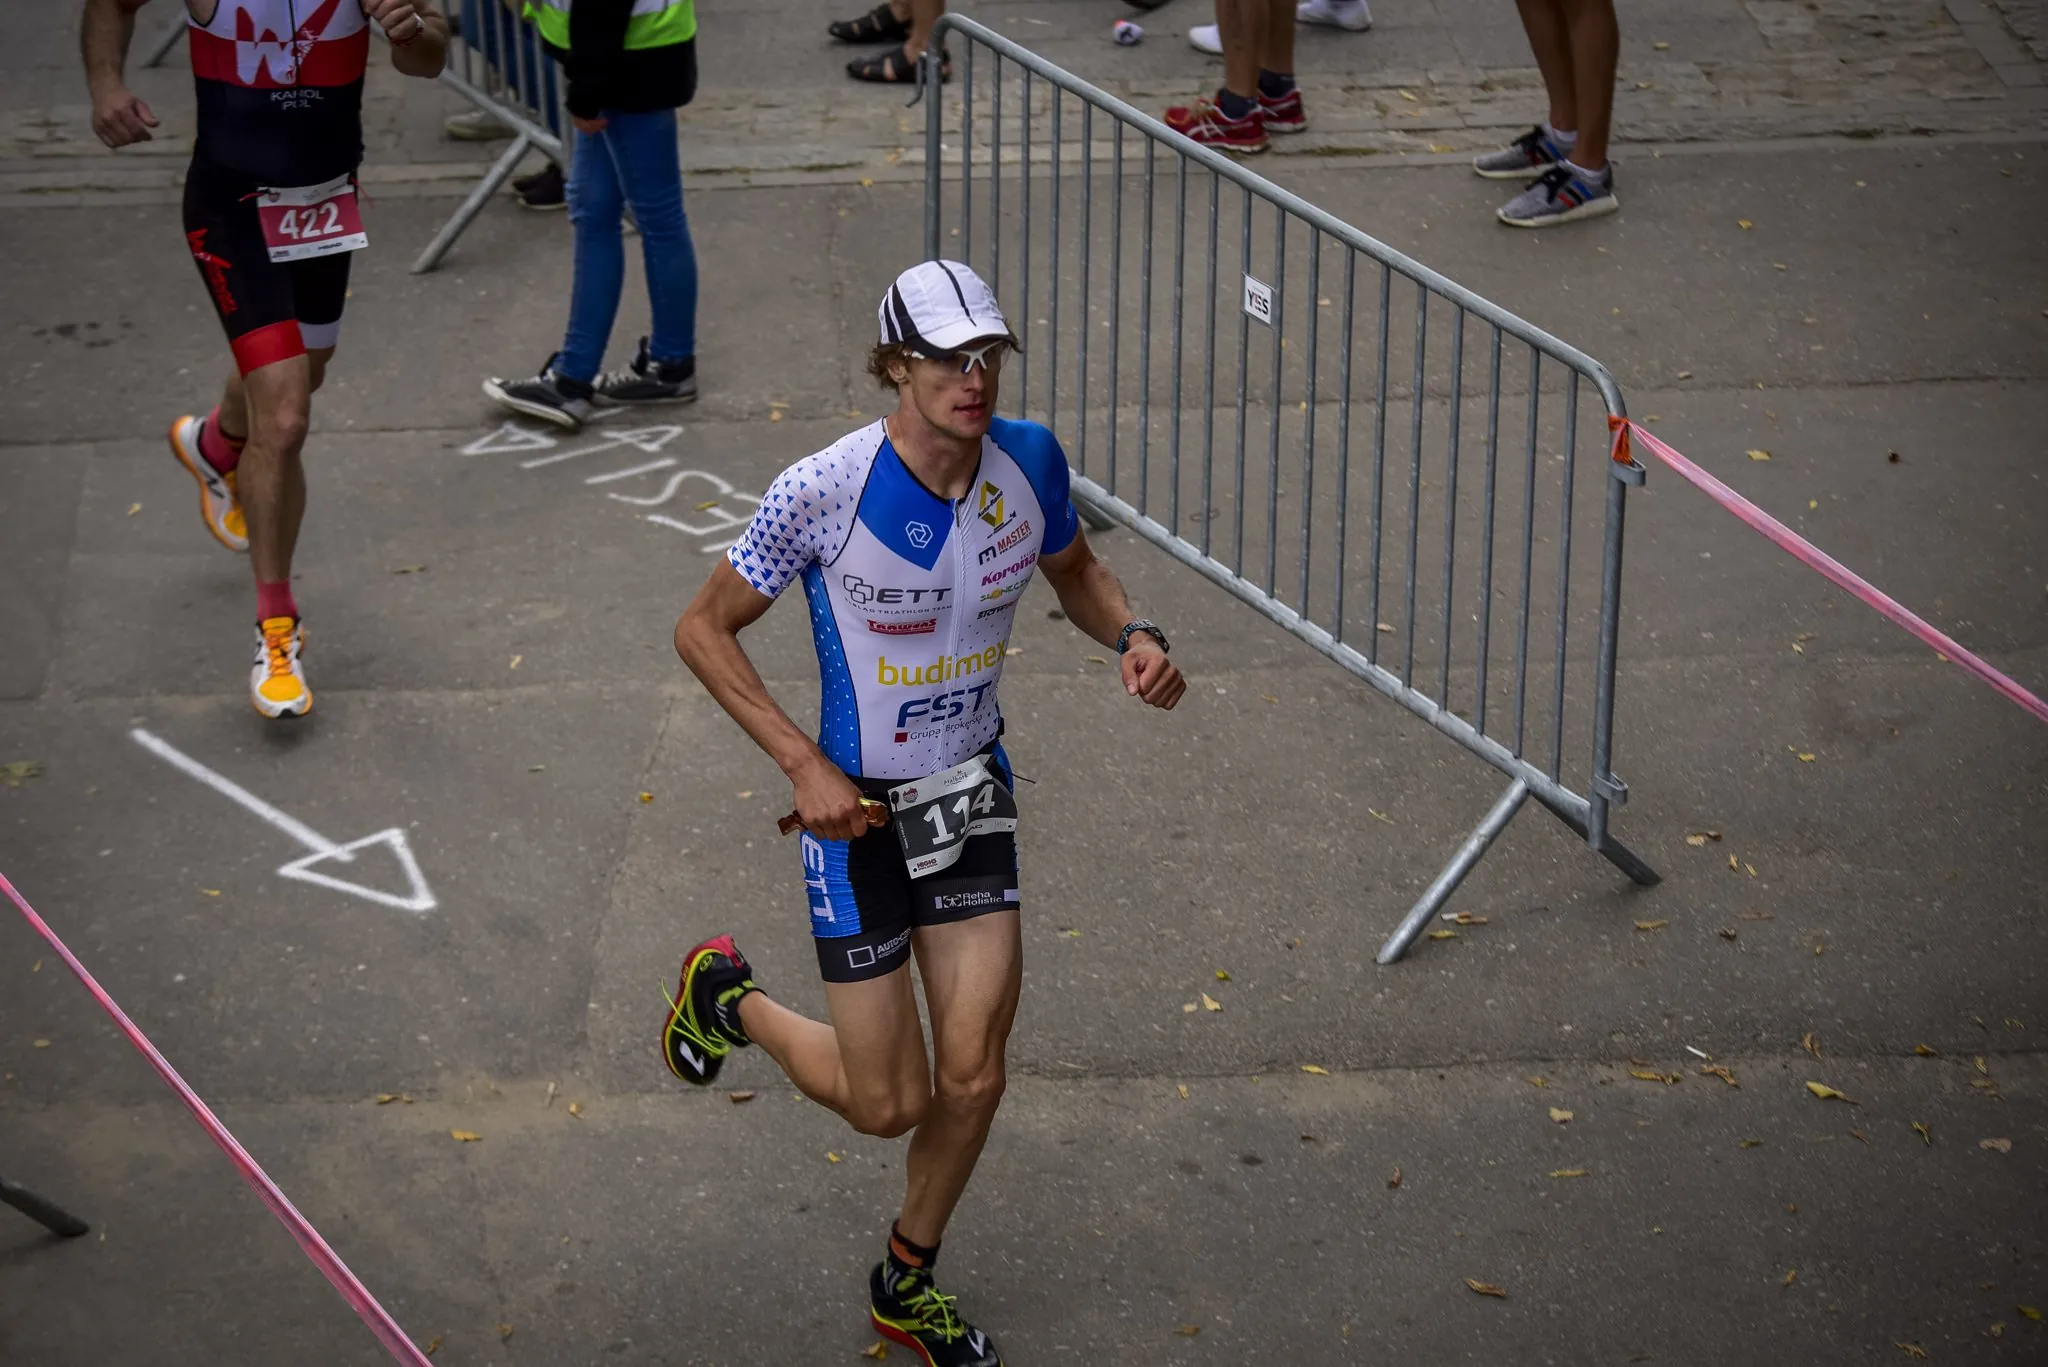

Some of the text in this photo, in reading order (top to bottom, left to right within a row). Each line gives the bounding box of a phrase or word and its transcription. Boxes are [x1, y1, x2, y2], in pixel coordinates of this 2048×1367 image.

[278, 202, 344, 239] 422
[1247, 288, 1269, 315] YES
[997, 520, 1031, 551] MASTER
[981, 552, 1036, 587] Korona
[876, 588, 953, 604] ETT
[878, 640, 1006, 686] budimex
[896, 680, 993, 728] FST
[910, 715, 983, 740] Grupa Brokerska
[923, 784, 996, 845] 114
[801, 834, 836, 923] ETT
[962, 891, 991, 899] Reha
[962, 896, 1002, 906] Holistic
